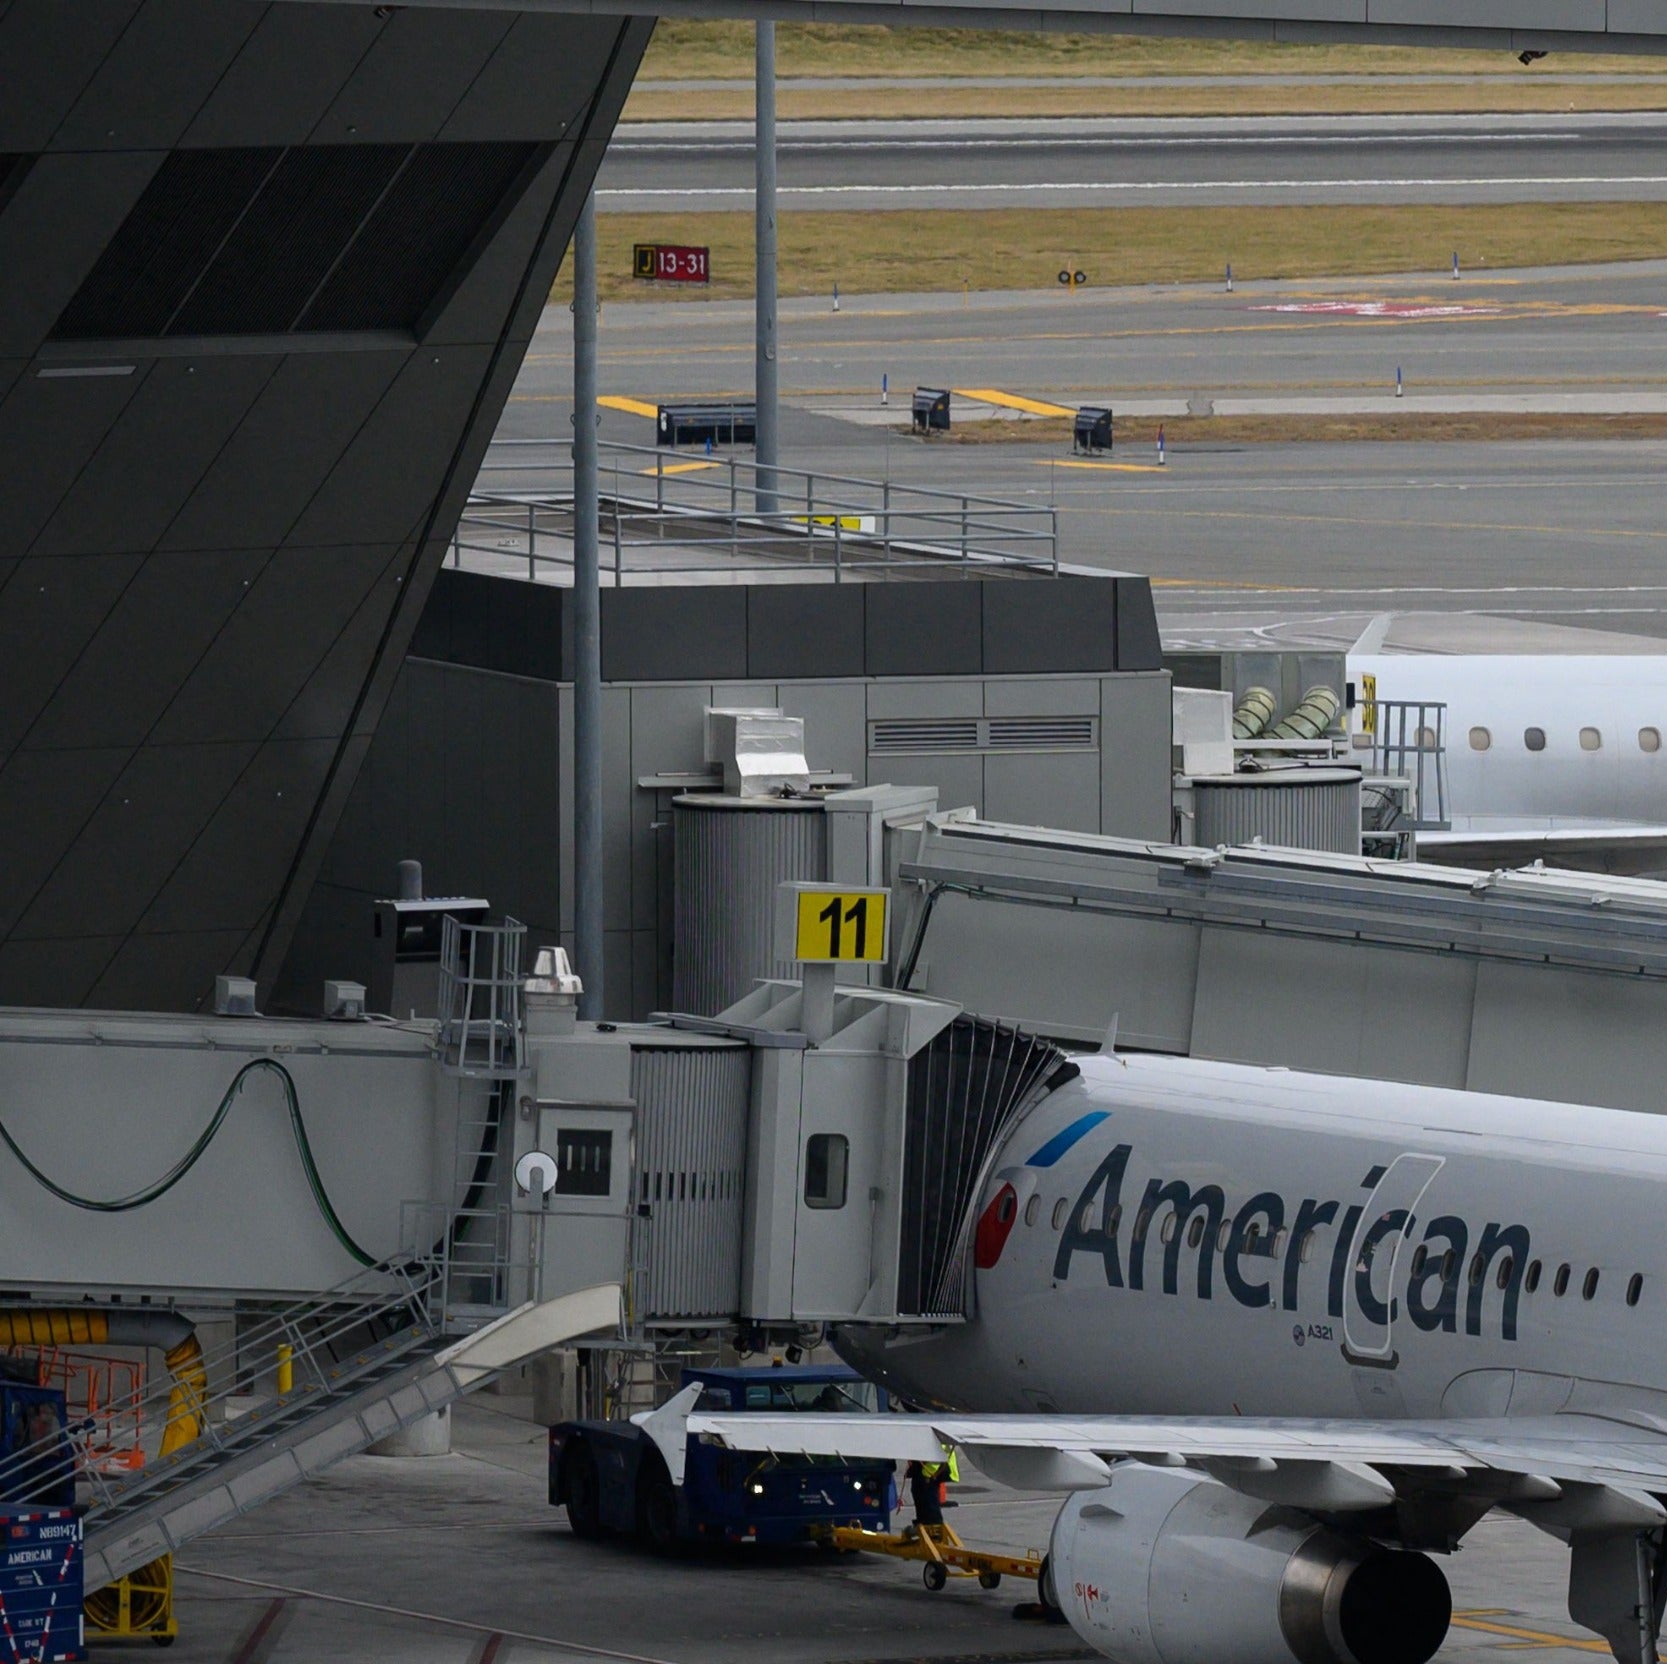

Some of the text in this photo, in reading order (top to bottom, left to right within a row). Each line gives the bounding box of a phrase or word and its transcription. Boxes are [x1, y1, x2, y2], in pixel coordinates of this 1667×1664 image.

[642, 250, 706, 275] J 13-31
[819, 896, 867, 959] 11
[1053, 1142, 1531, 1341] American
[1307, 1323, 1333, 1341] A321
[8, 1548, 53, 1565] AMERICAN
